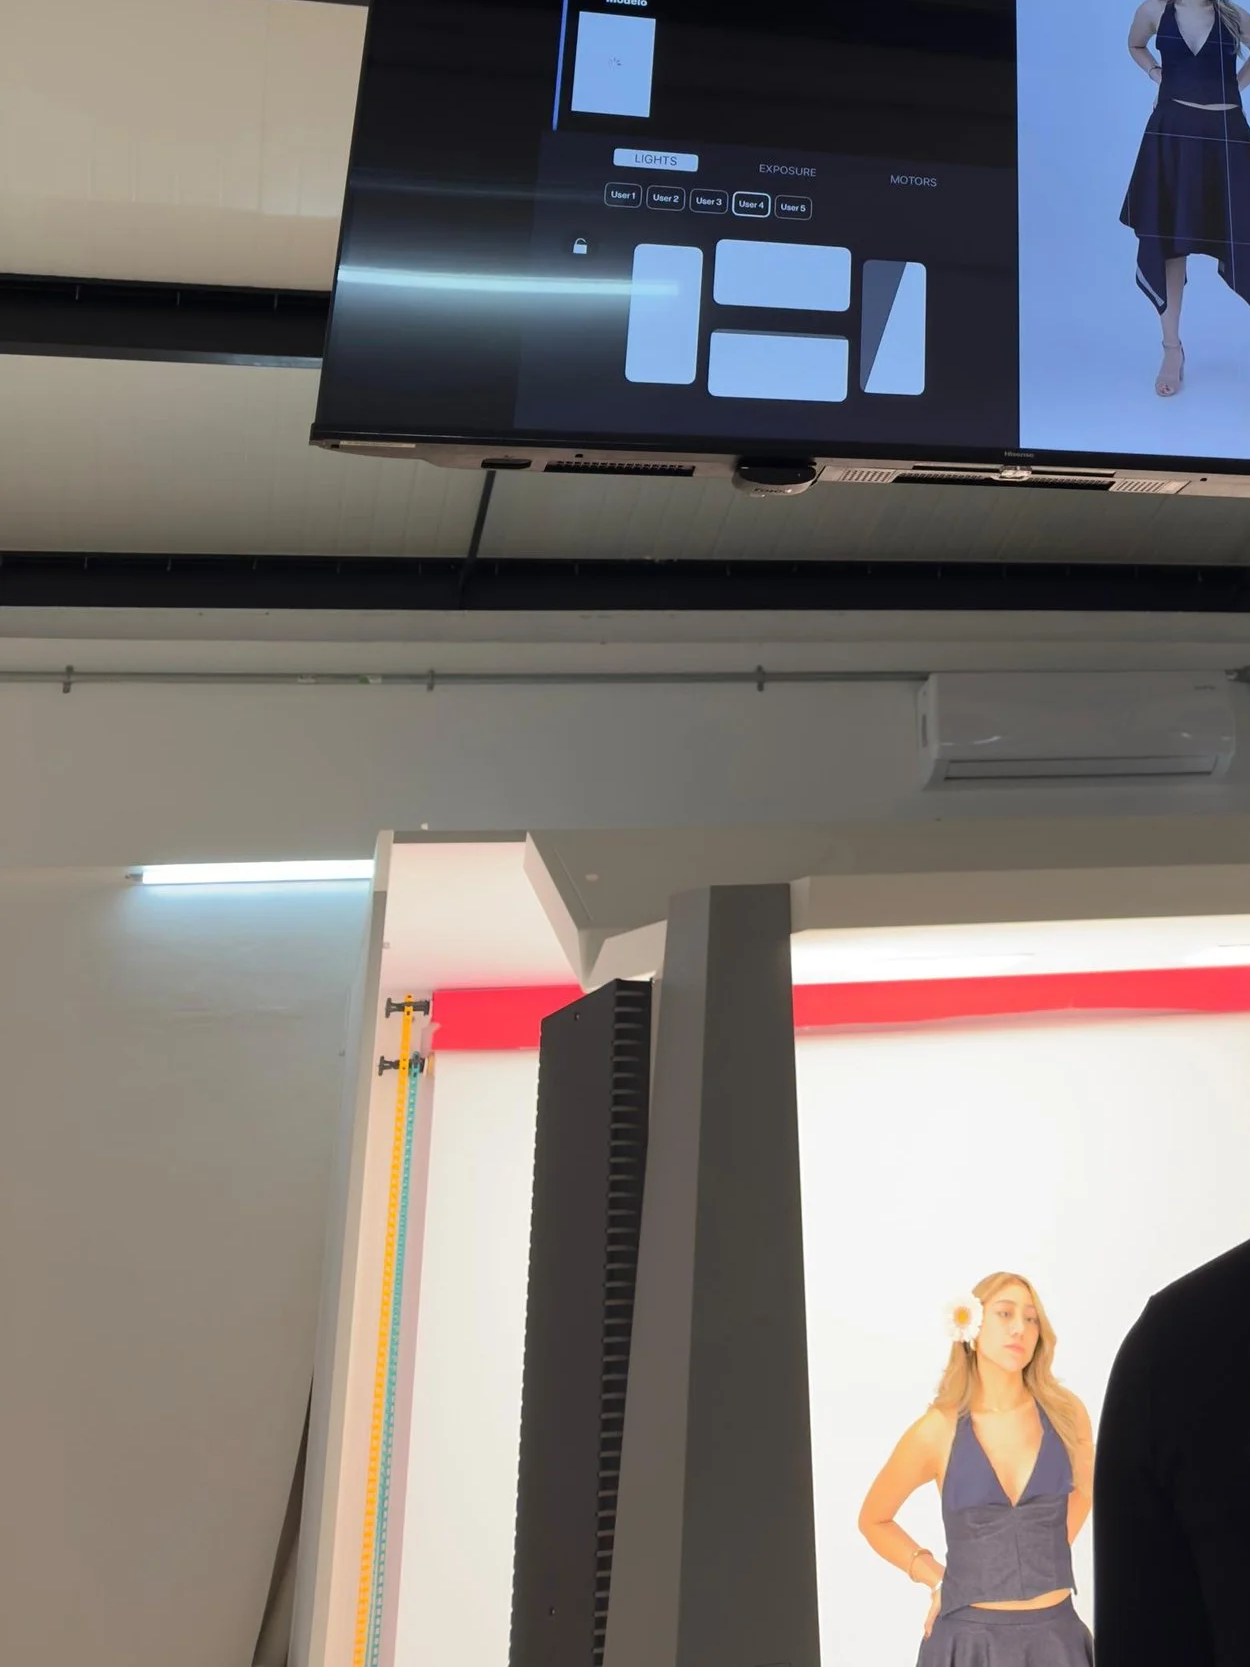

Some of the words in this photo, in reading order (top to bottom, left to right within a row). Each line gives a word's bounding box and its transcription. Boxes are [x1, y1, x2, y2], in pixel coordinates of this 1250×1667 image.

[634, 154, 677, 166] LIGHTS
[759, 163, 817, 177] EXPOSURE
[890, 174, 937, 187] MOTORS
[611, 190, 631, 199] User
[652, 193, 671, 202] User
[695, 196, 715, 206] User
[738, 200, 757, 209] User
[780, 203, 799, 212] User
